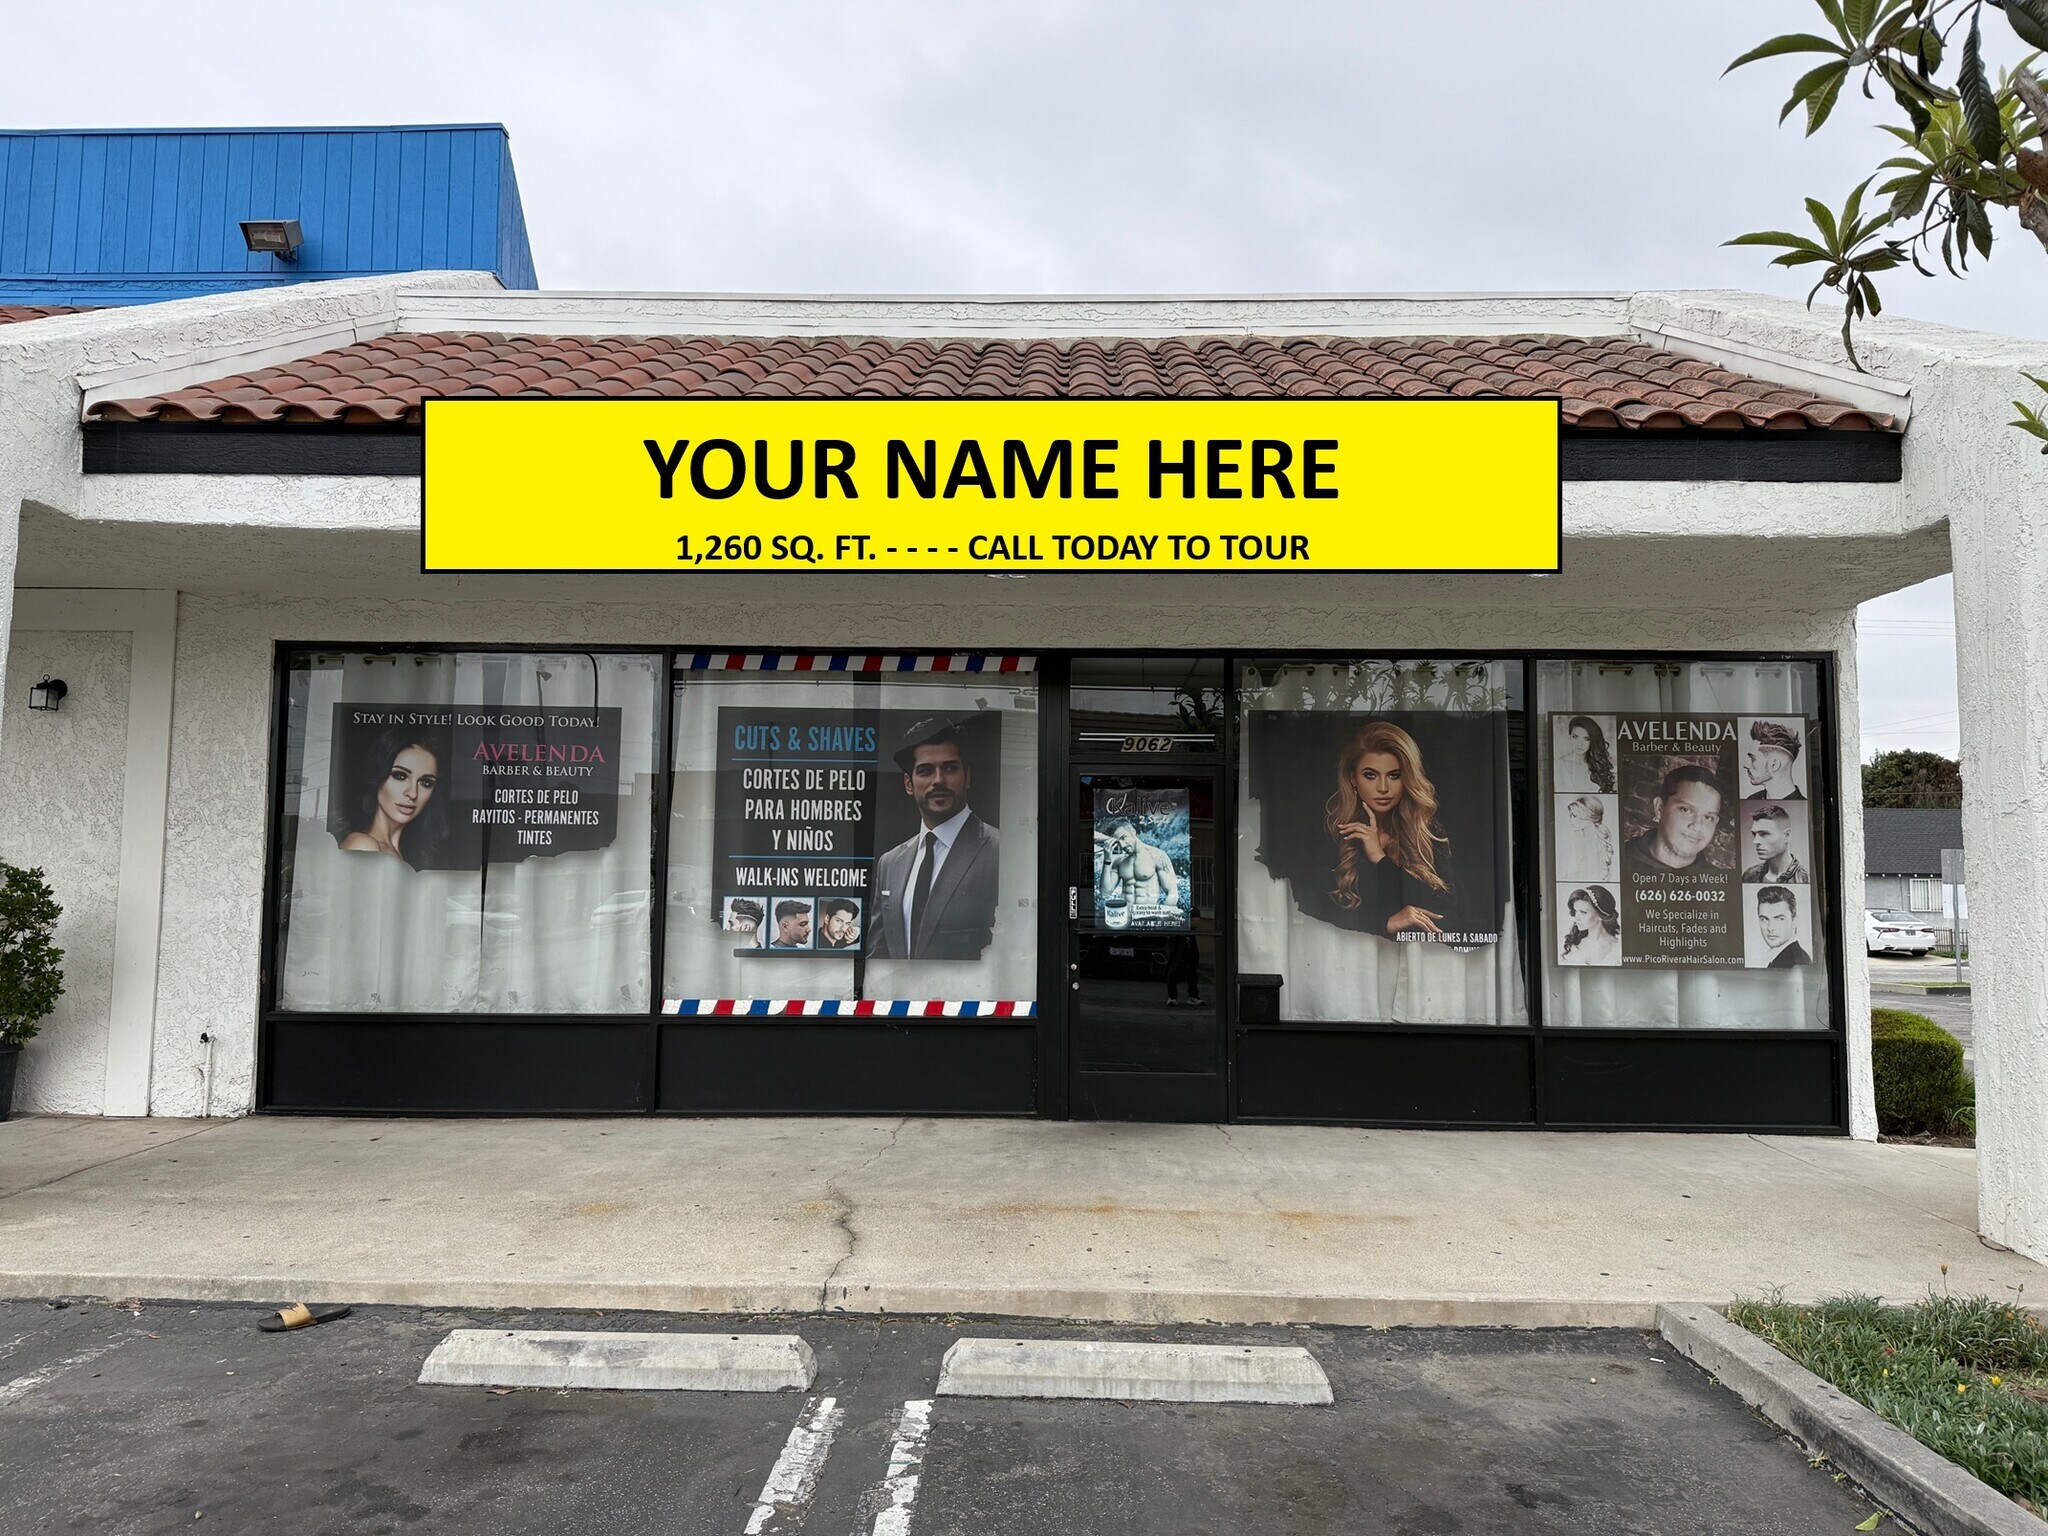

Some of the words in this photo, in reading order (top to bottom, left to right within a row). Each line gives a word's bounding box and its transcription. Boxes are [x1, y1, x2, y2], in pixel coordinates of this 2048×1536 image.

[354, 712, 384, 723] STAY
[389, 715, 403, 723] IN
[409, 713, 451, 724] STYLE!
[458, 714, 495, 725] LOOK
[500, 715, 544, 726] GOOD
[549, 716, 599, 727] TODAY!
[1618, 721, 1737, 741] AVELENDA
[735, 725, 781, 751] CUTS
[788, 728, 800, 750] &
[808, 727, 876, 752] SHAVES
[1123, 737, 1171, 751] 9062
[472, 741, 605, 763] AVELENDA
[1632, 742, 1668, 752] Barber
[1672, 743, 1680, 751] &
[1684, 743, 1721, 755] Beauty
[482, 765, 529, 776] BARBER
[533, 766, 542, 775] &
[547, 766, 593, 776] BEAUTY
[744, 768, 799, 789] CORTES
[806, 770, 823, 789] DE
[830, 770, 865, 790] PELO
[495, 789, 533, 803] CORTES
[537, 790, 550, 803] DE
[554, 790, 578, 804] PELO
[473, 809, 515, 823] RAYITOS
[525, 810, 599, 825] PERMANENTES
[745, 799, 784, 819] PARA
[791, 800, 861, 821] HOMBRES
[517, 831, 552, 844] TINTES
[773, 830, 781, 850] Y
[787, 826, 833, 851] NIÑOS
[736, 868, 798, 886] WALK-INS
[804, 868, 867, 887] WELCOME
[1633, 873, 1656, 885] Open
[1660, 873, 1665, 882] 7
[1669, 873, 1689, 886] Days
[1700, 874, 1727, 883] Week!
[1635, 889, 1667, 903] (626)
[1670, 891, 1725, 901] 626-0032
[1646, 910, 1660, 919] We
[1663, 909, 1708, 923] Specialize
[1711, 910, 1719, 919] in
[1638, 922, 1679, 934] Haircuts,
[1682, 923, 1707, 933] Fades
[1710, 924, 1726, 933] and
[1396, 932, 1425, 942] ABIERTO
[1428, 932, 1436, 942] DE
[1439, 932, 1461, 943] LUNES
[1463, 933, 1468, 942] A
[1470, 933, 1498, 943] SABADO
[1660, 937, 1707, 949] Highlights
[1623, 954, 1744, 965] www.PicoRiveraHairSalon.com
